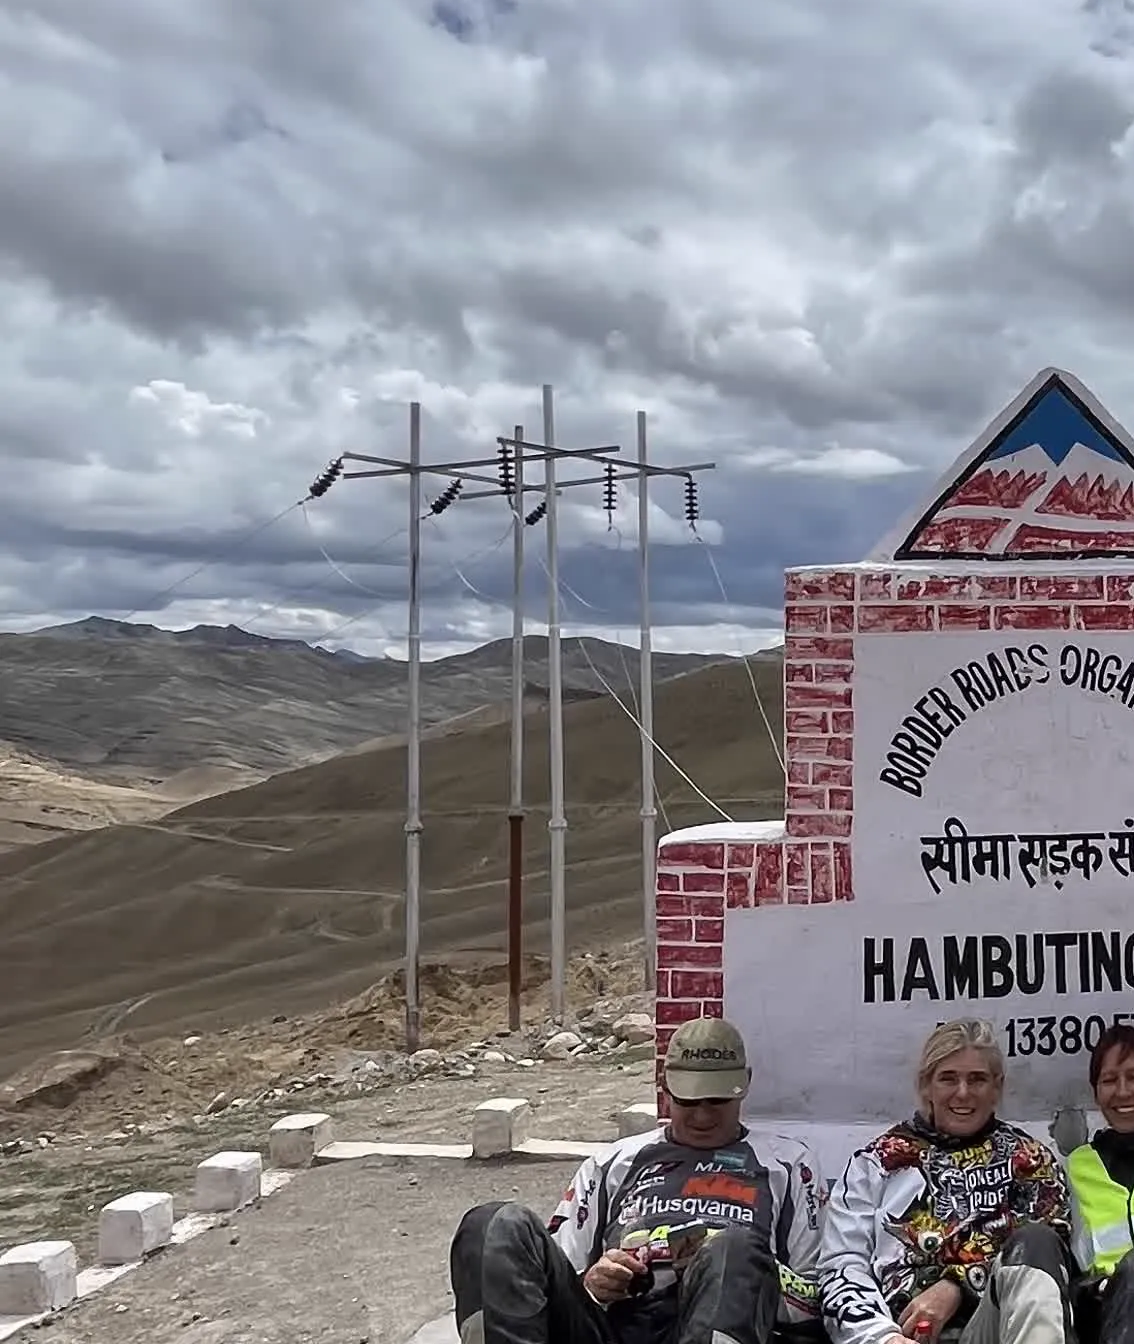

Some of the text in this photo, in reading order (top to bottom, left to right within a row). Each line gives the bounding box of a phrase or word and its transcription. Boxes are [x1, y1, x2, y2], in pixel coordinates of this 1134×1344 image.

[879, 686, 967, 797] BORDER
[950, 644, 1050, 712] ROADS
[920, 817, 1016, 894] सीमा
[1018, 833, 1105, 890] सड़क
[1005, 1015, 1105, 1057] 13380
[641, 1195, 754, 1222] Husqvarna
